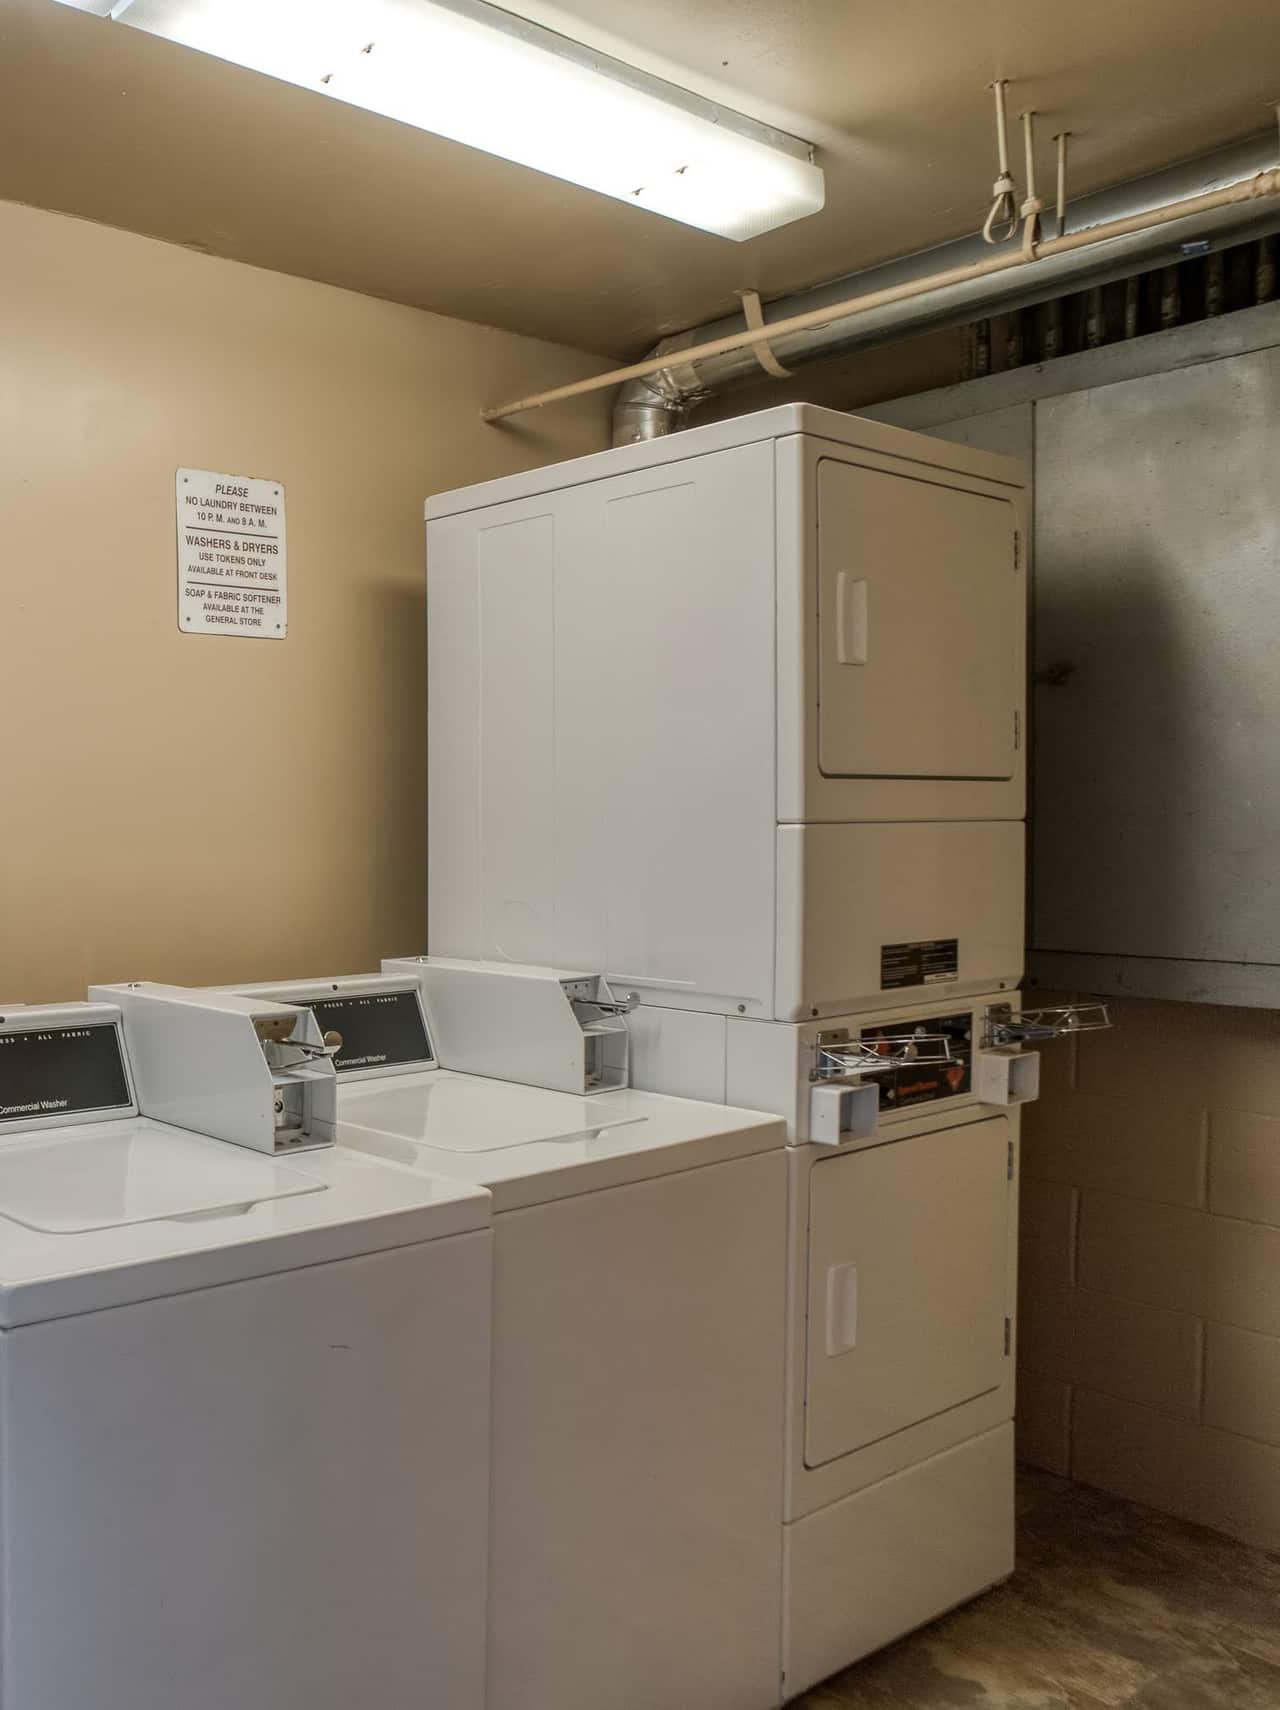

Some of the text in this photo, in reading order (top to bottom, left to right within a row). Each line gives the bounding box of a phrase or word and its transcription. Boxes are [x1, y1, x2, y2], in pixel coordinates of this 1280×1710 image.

[216, 484, 249, 498] PLEASE
[185, 496, 277, 516] NO LAUNDRY BETWEEN
[198, 512, 206, 521] 10
[227, 517, 240, 525] AND
[185, 535, 279, 555] WASHERS & DRYERS
[198, 552, 266, 567] USE TOKENS ONLY
[188, 565, 278, 581] AVAILABLE AT FRONT DESK
[185, 588, 281, 604] SOAP & FABRIC SOFTENER
[203, 602, 264, 615] AVAILABLE AT THE
[205, 614, 262, 626] GENERAL STORE
[61, 1030, 91, 1038] FABRIC
[40, 1099, 68, 1109] Washer
